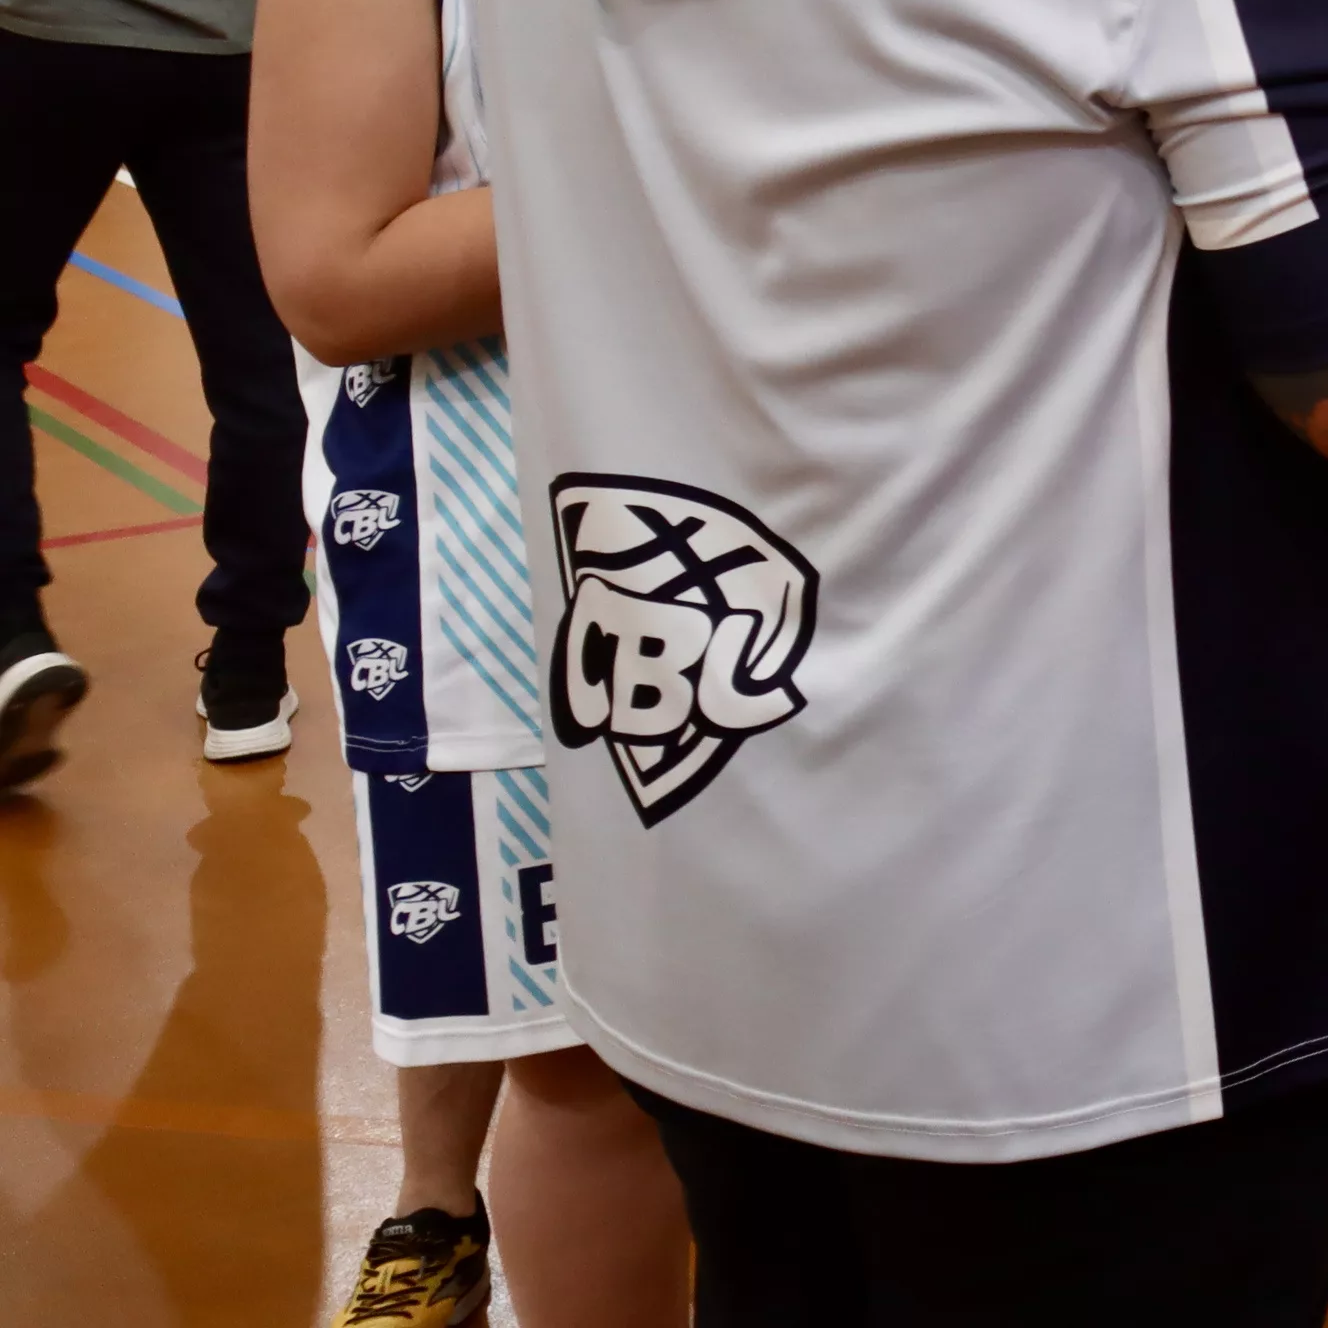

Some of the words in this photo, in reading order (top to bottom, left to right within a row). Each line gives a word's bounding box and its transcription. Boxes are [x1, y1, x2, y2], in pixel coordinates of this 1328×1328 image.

[334, 506, 401, 545] CBL
[351, 656, 409, 691] CBL
[556, 573, 802, 742] CBL
[390, 898, 462, 936] CBL
